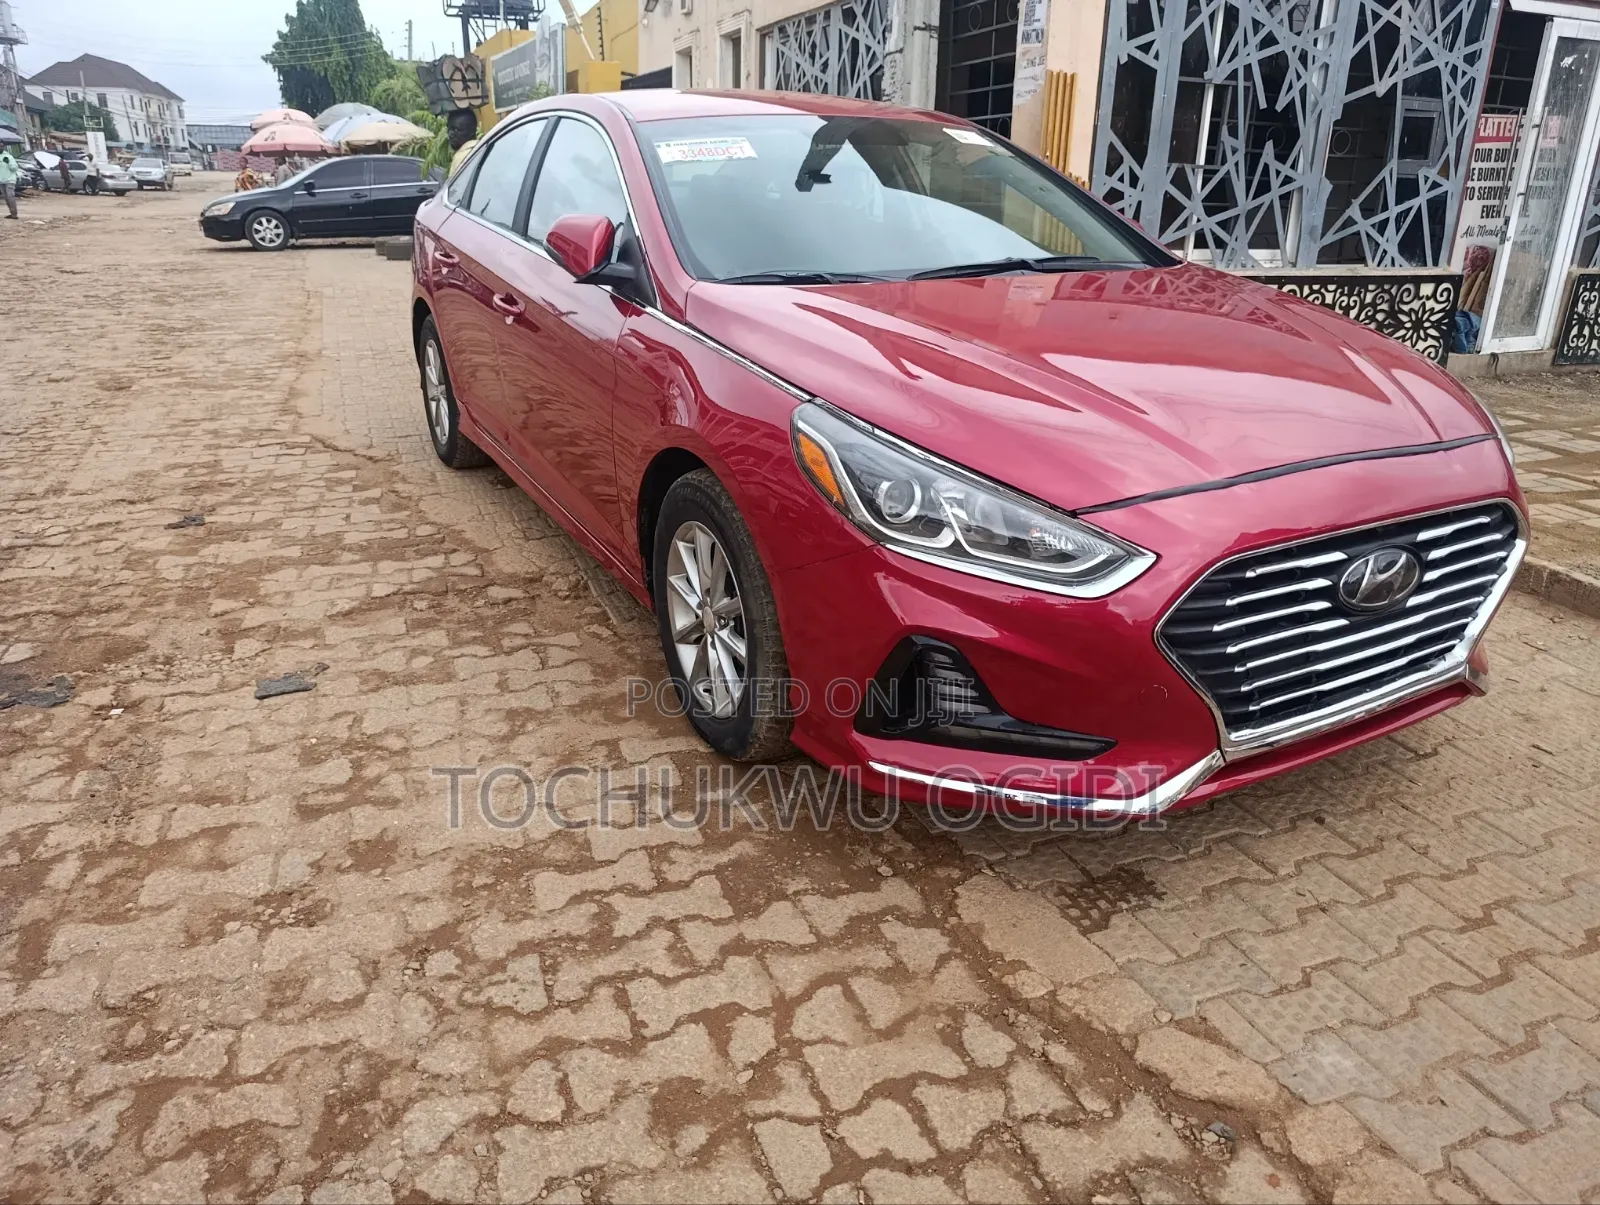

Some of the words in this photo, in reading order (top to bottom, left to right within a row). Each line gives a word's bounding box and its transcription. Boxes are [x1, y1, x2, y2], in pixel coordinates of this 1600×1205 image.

[1474, 147, 1493, 163] OUR
[1465, 186, 1475, 201] TO
[1460, 224, 1475, 239] All
